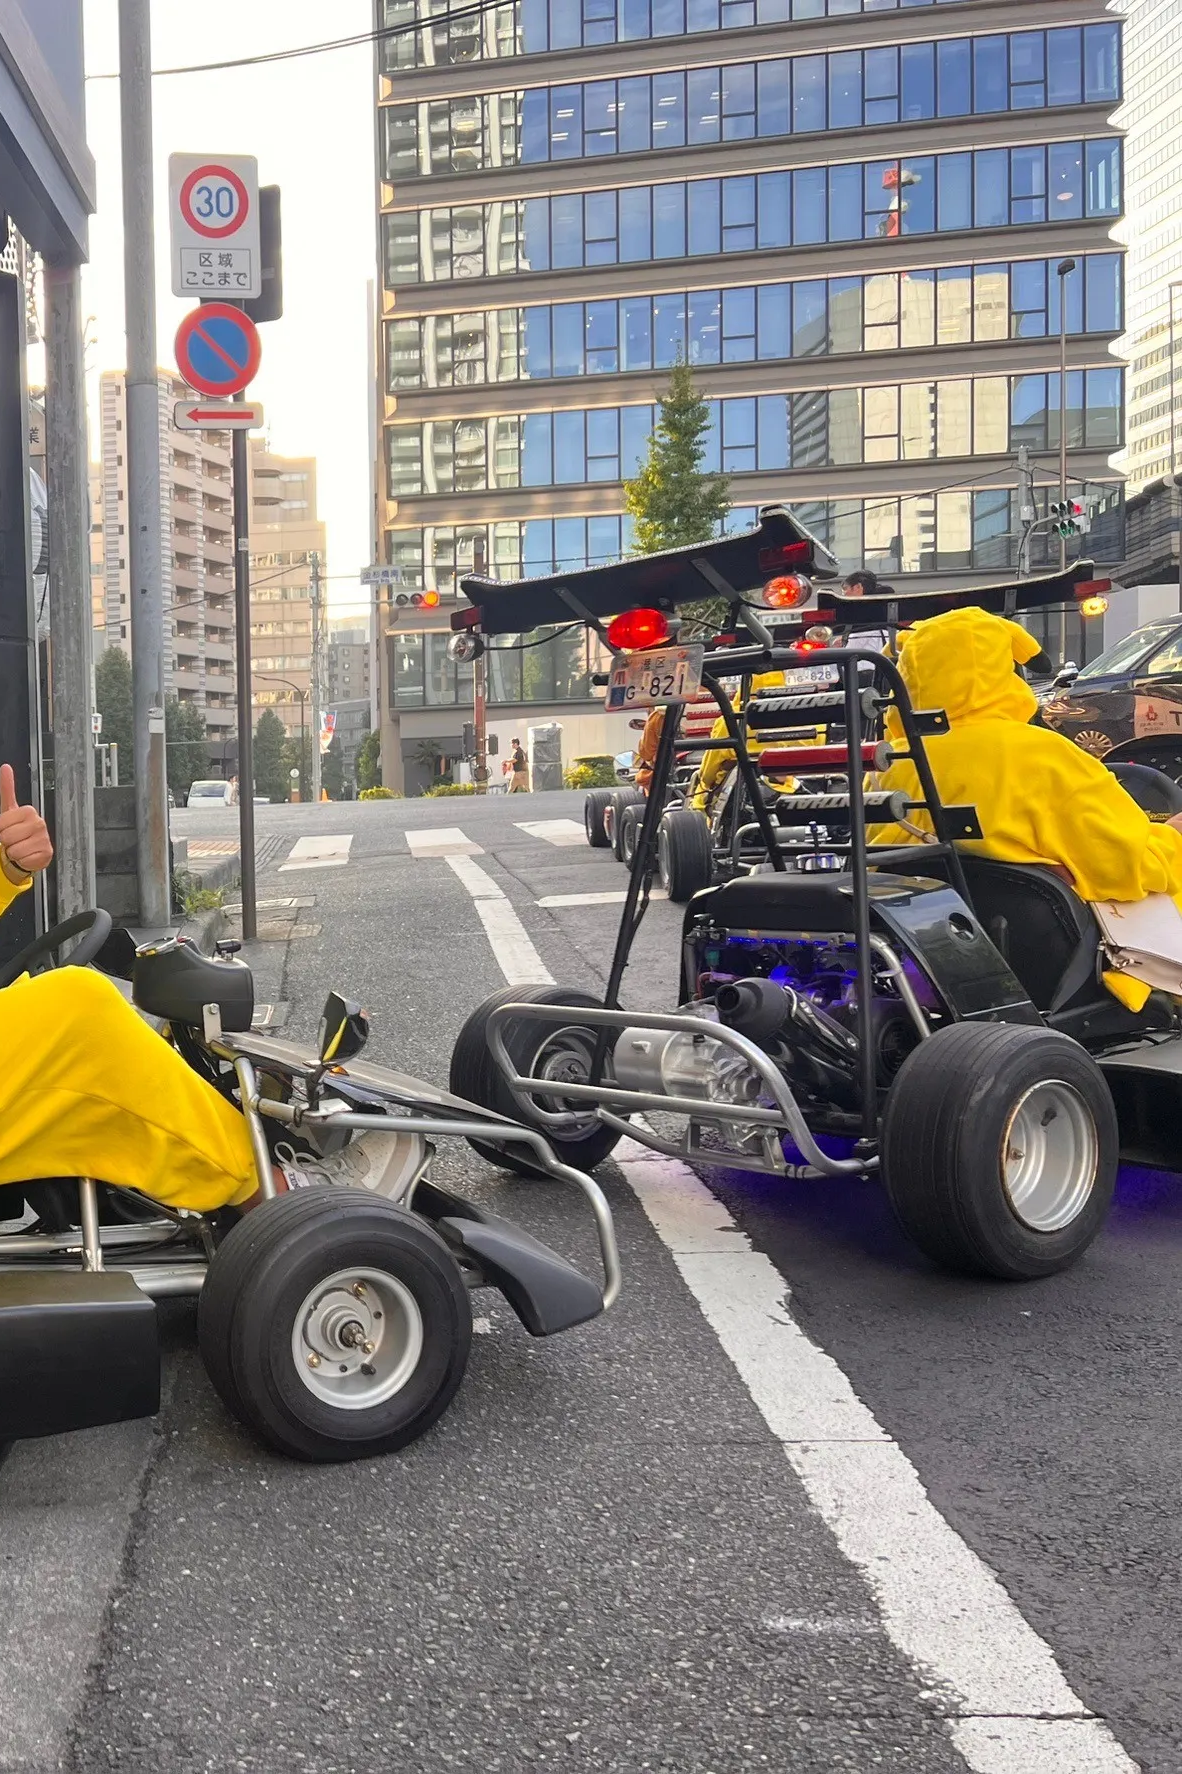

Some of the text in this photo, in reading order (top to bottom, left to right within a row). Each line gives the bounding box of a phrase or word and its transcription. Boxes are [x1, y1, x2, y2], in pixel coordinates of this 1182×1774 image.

[196, 186, 234, 218] 30
[199, 253, 233, 268] 区域
[186, 271, 248, 286] ここまで
